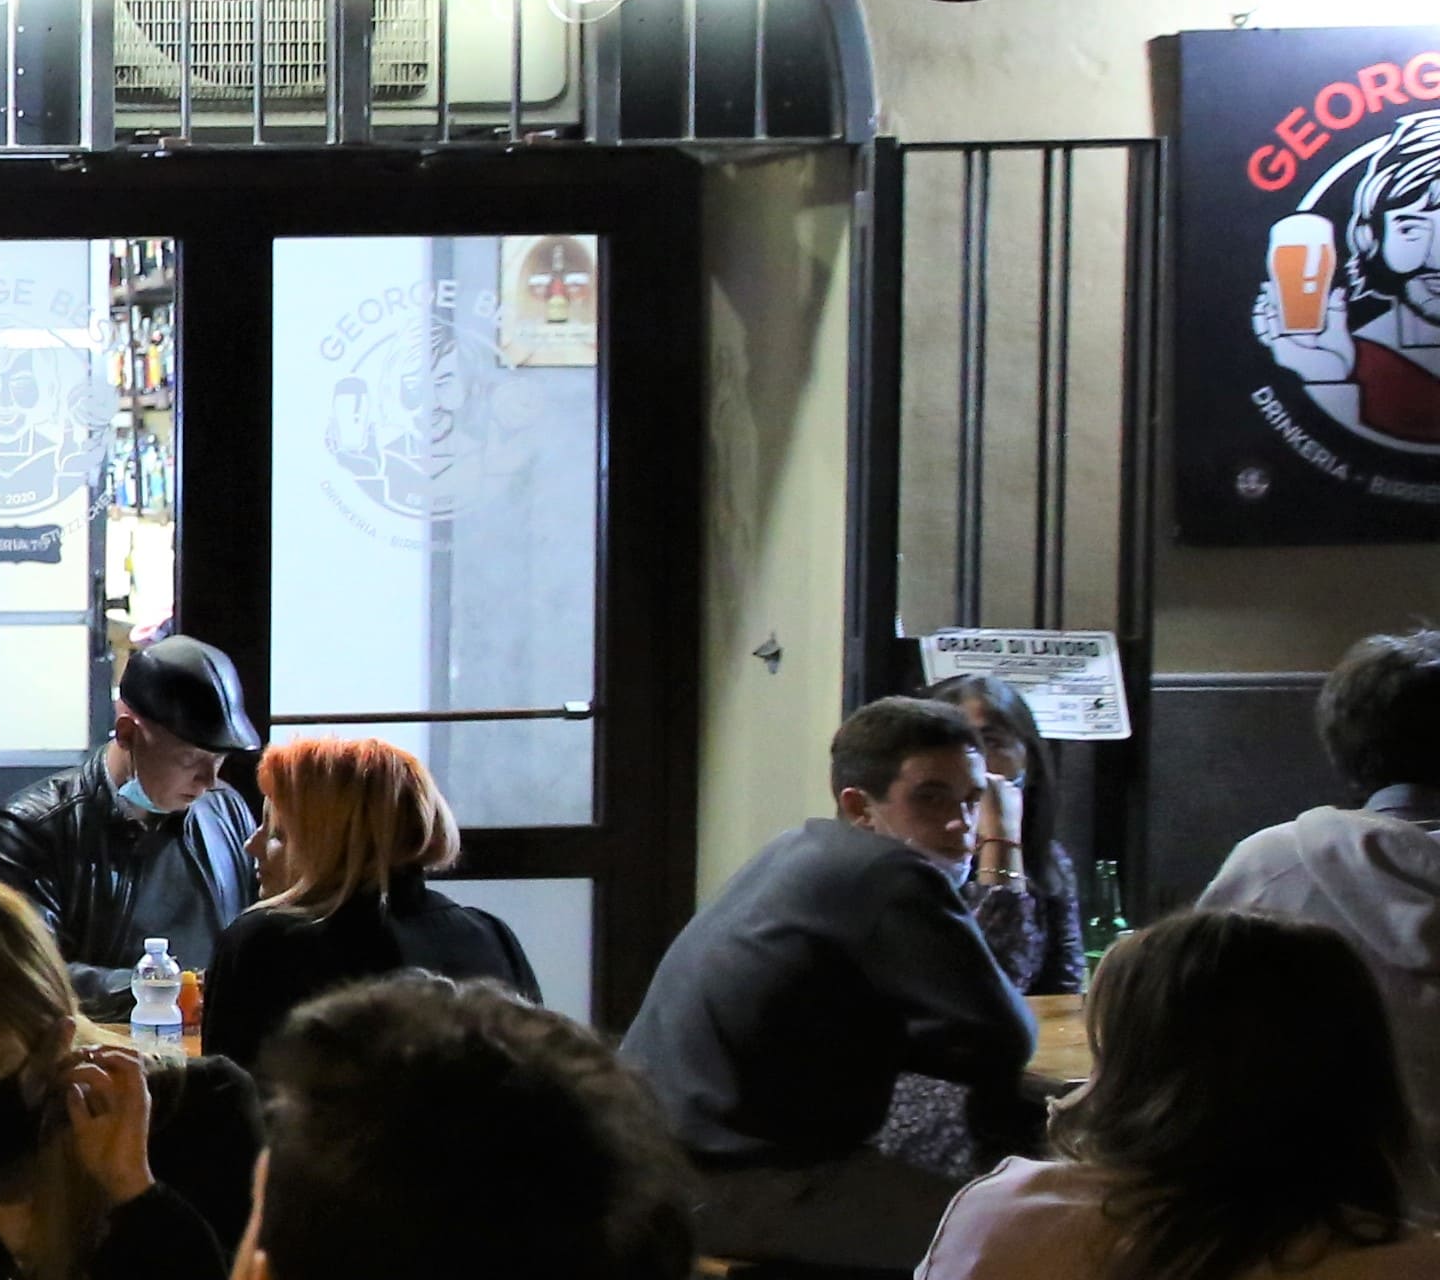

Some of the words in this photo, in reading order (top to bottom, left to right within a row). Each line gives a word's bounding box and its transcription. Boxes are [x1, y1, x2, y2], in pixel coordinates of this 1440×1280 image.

[1250, 384, 1349, 482] DRINKERIA
[937, 637, 1003, 654] ORARIO
[1008, 638, 1025, 654] DI
[1032, 639, 1099, 657] LAVORO
